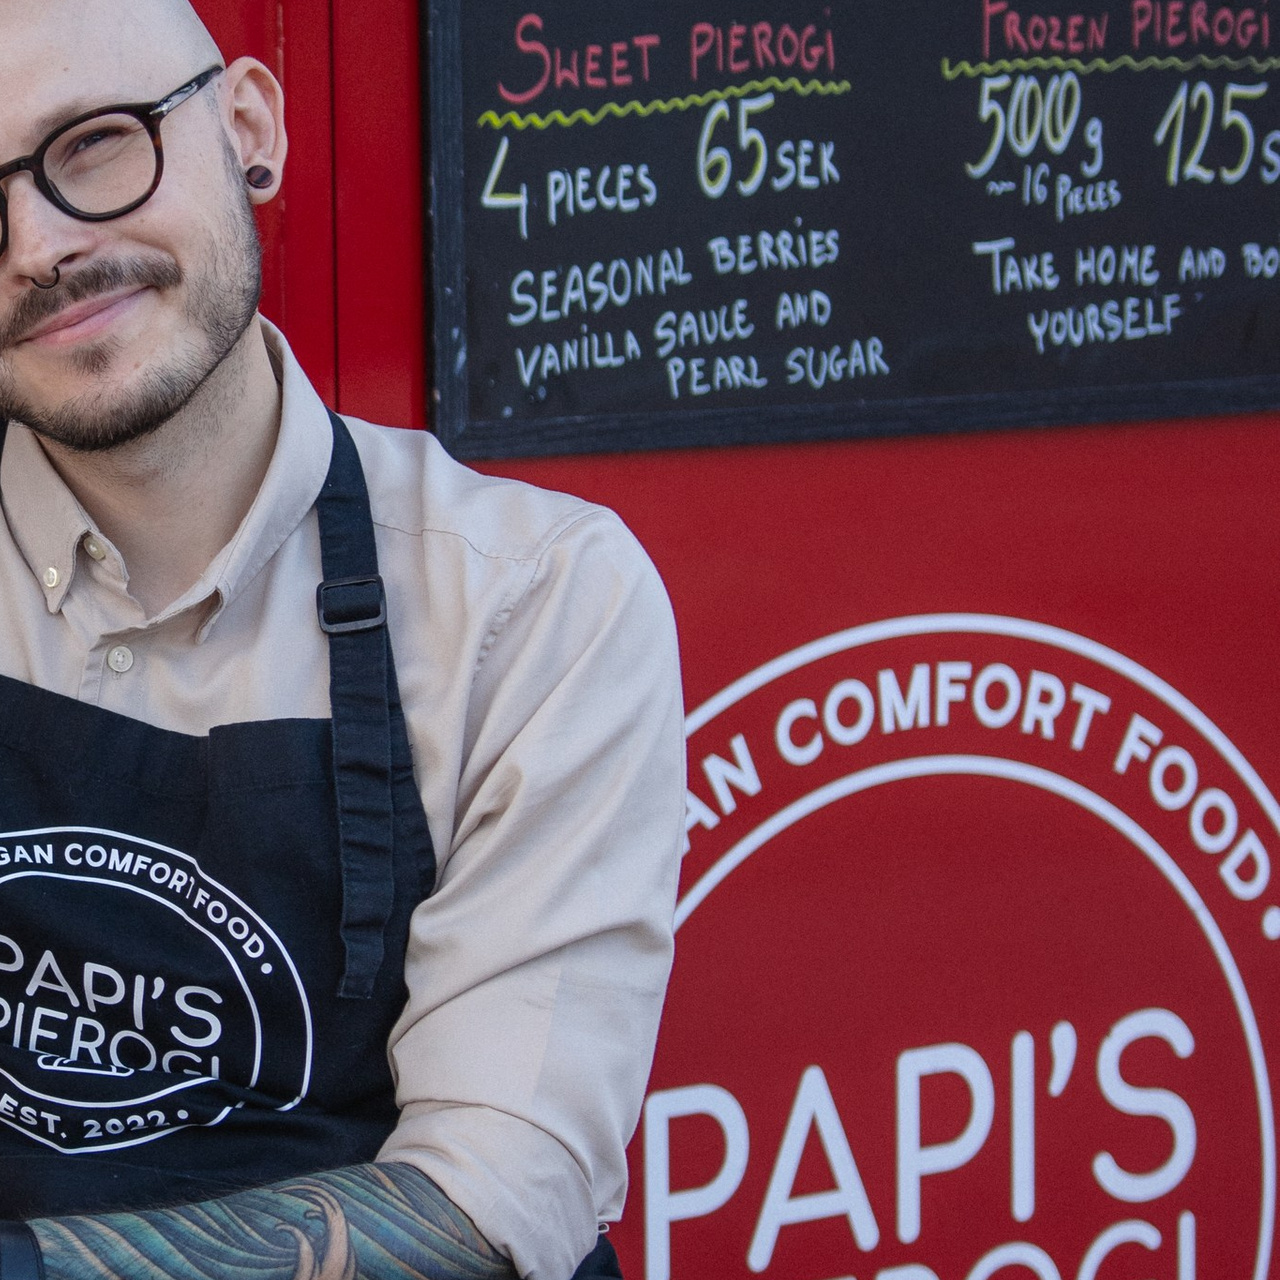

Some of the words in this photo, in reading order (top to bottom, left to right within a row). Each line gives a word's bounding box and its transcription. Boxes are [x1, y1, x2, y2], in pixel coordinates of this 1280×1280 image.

[480, 135, 530, 240] 4
[547, 163, 658, 226] PIECES
[696, 93, 775, 200] 65
[771, 140, 841, 192] SEK
[1153, 79, 1270, 186] 125
[508, 246, 693, 326] SEASONAL
[972, 237, 1060, 296] TAKE
[1075, 244, 1160, 286] HOME
[1178, 245, 1227, 283] AND
[655, 298, 755, 358] SAUCE
[775, 291, 832, 331] AND
[1028, 293, 1181, 354] YOURSELF
[667, 354, 768, 400] PEARL
[785, 335, 889, 389] SUGAR
[774, 660, 1112, 766] COMFORT
[1115, 713, 1272, 900] FOOD
[192, 888, 266, 960] FOOD
